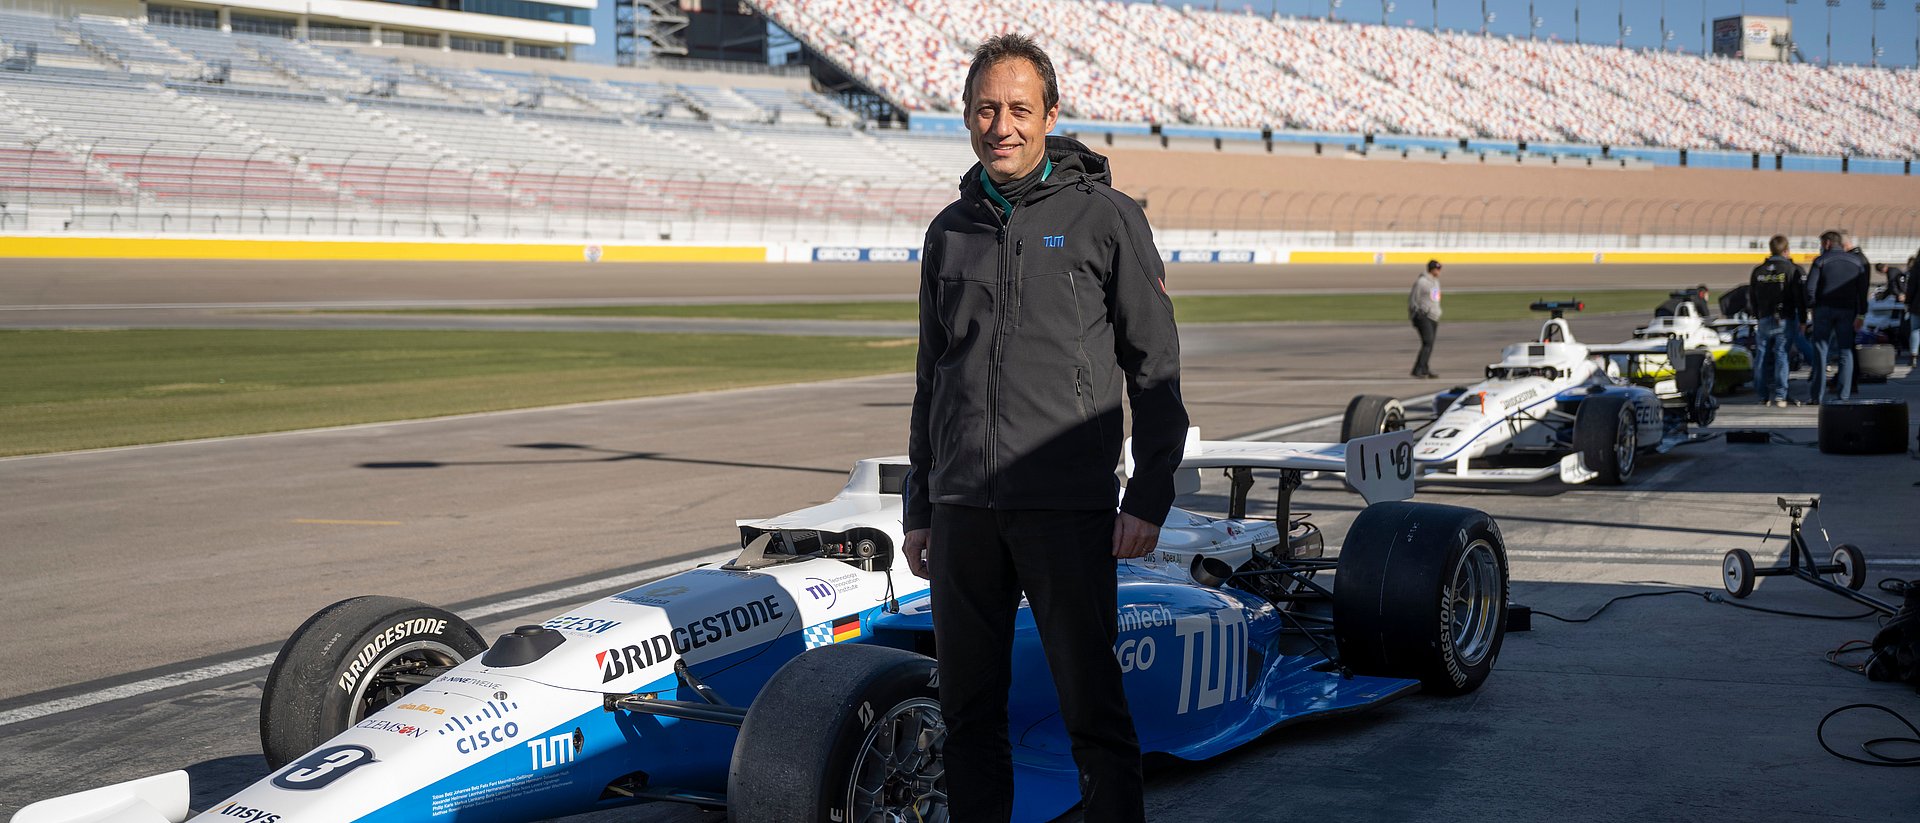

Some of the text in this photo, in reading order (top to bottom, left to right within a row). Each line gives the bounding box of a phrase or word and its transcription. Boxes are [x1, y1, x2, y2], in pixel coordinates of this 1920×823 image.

[1043, 235, 1065, 248] TUM
[1399, 444, 1409, 475] 3
[563, 618, 622, 633] ESN
[1117, 604, 1172, 633] intech
[596, 594, 784, 684] BRIDGESTONE
[1440, 584, 1468, 688] BRIDGESTONE
[339, 618, 447, 695] BRIDGESTONE
[1112, 636, 1156, 673] GO
[1175, 607, 1249, 715] TUM
[456, 721, 519, 754] CISCO
[527, 731, 574, 770] TUM
[285, 749, 365, 782] 3
[208, 800, 282, 823] Ansys
